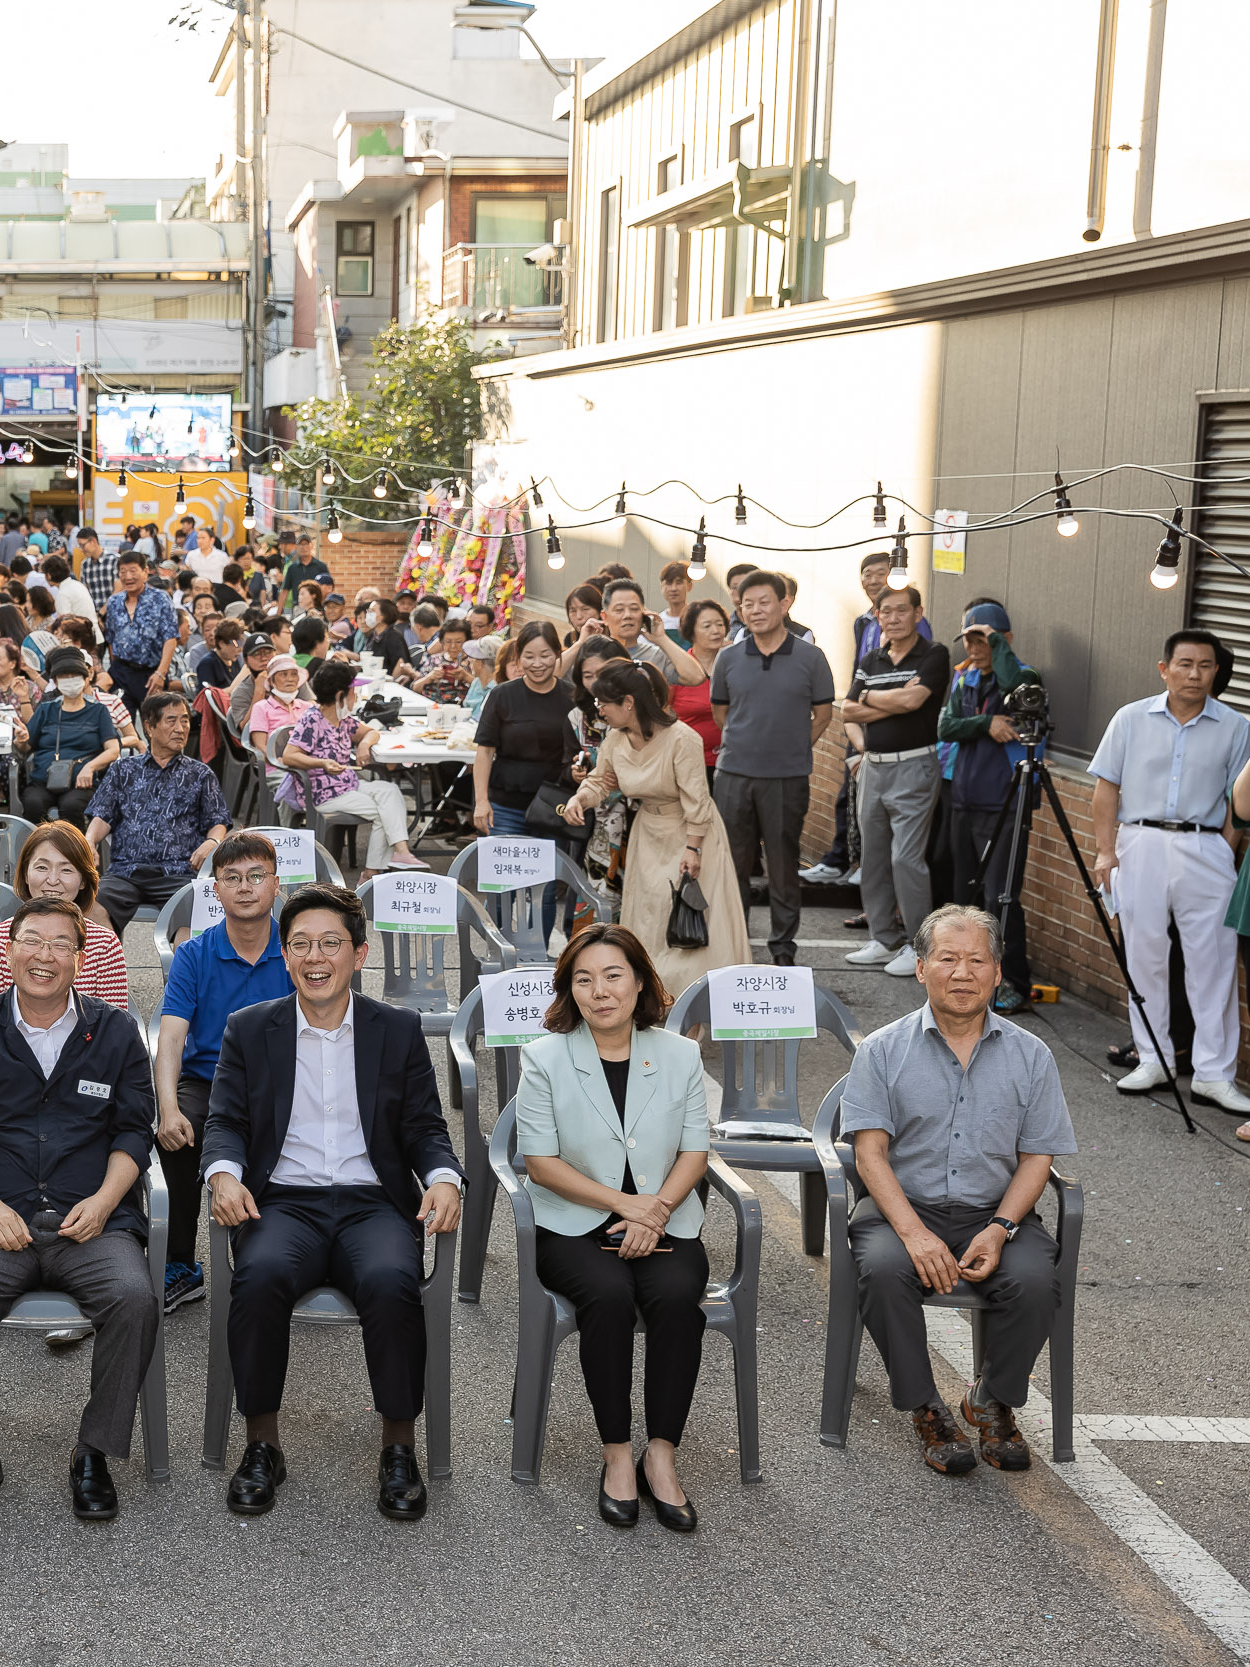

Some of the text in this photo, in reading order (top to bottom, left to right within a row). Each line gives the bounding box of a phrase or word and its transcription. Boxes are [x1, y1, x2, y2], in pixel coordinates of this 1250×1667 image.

[492, 846, 541, 858] 새마을시장
[494, 864, 522, 875] 임재복
[395, 881, 437, 894] 화양시장
[391, 901, 421, 914] 최규철
[508, 981, 556, 997] 신성시장
[737, 976, 788, 991] 자양시장
[504, 1006, 542, 1021] 송병호
[733, 1001, 795, 1015] 박호규 회장님
